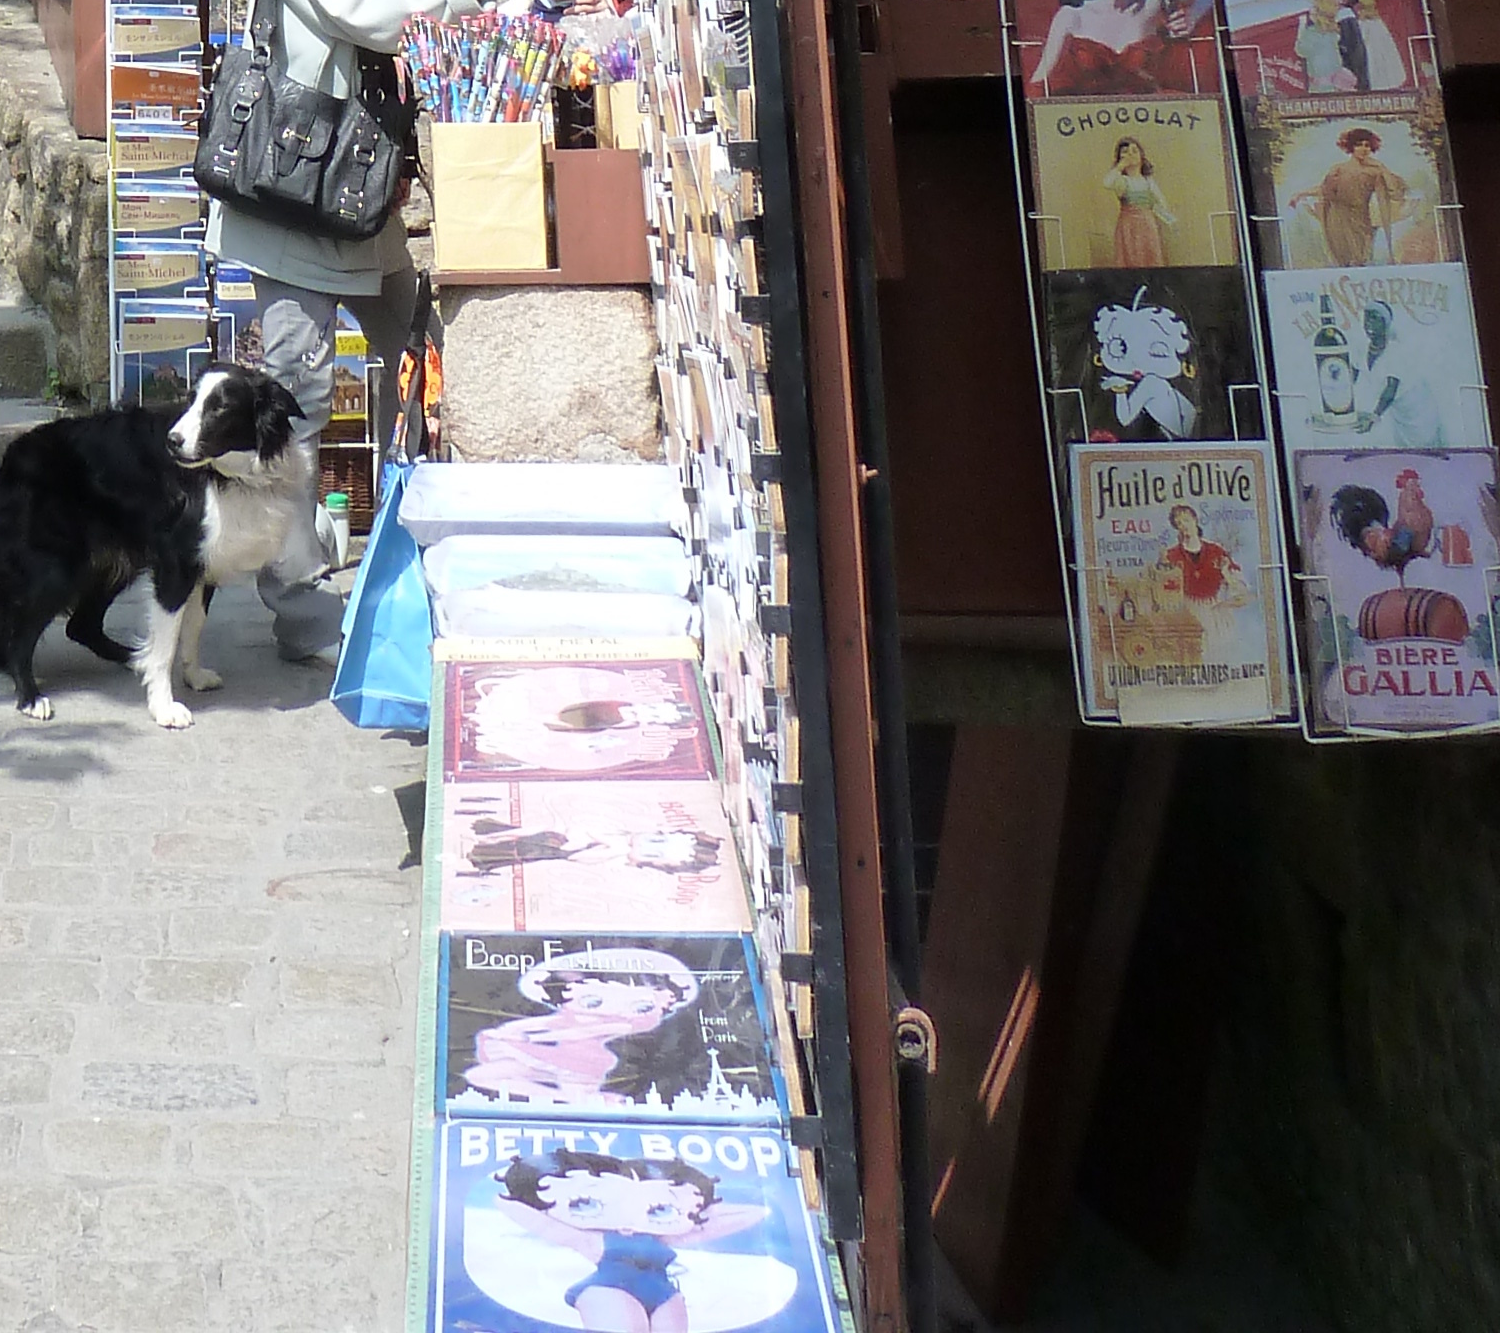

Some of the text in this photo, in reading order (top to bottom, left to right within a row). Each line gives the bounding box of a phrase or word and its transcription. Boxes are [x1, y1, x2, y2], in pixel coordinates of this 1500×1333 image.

[1278, 96, 1416, 116] CHAMPAGNE POMMERY
[1056, 107, 1202, 137] CHOCOLAT
[121, 151, 189, 161] Saint-Michel
[117, 267, 186, 278] Saint-Michel
[1321, 275, 1449, 330] NEGRITA
[1096, 461, 1251, 519] Huile d'Olive
[1112, 519, 1151, 535] EAU
[1117, 558, 1145, 567] EXTRA
[1376, 645, 1459, 665] BIÈRE
[1343, 665, 1498, 696] GALLIA
[667, 874, 721, 905] Boop
[465, 938, 535, 975] Boop
[701, 1025, 738, 1044] Paris
[460, 1125, 783, 1178] BETTY BOOP
